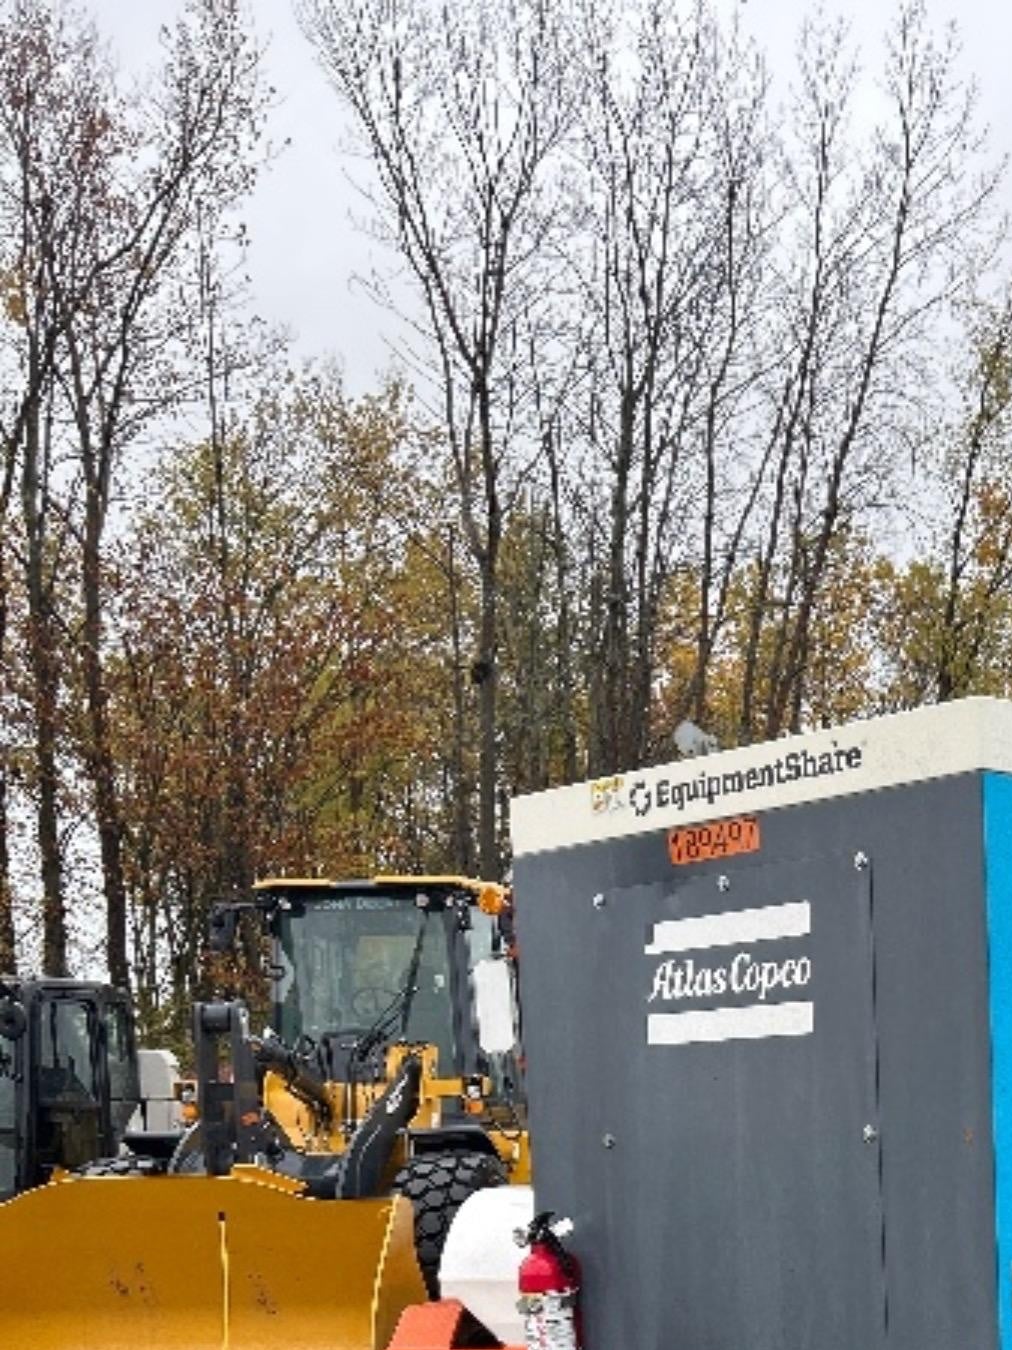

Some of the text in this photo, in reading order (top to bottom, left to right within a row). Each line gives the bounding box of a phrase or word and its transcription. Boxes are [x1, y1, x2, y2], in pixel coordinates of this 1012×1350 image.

[656, 745, 862, 811] EquipmentShare
[647, 951, 812, 1002] Atlas Copco
